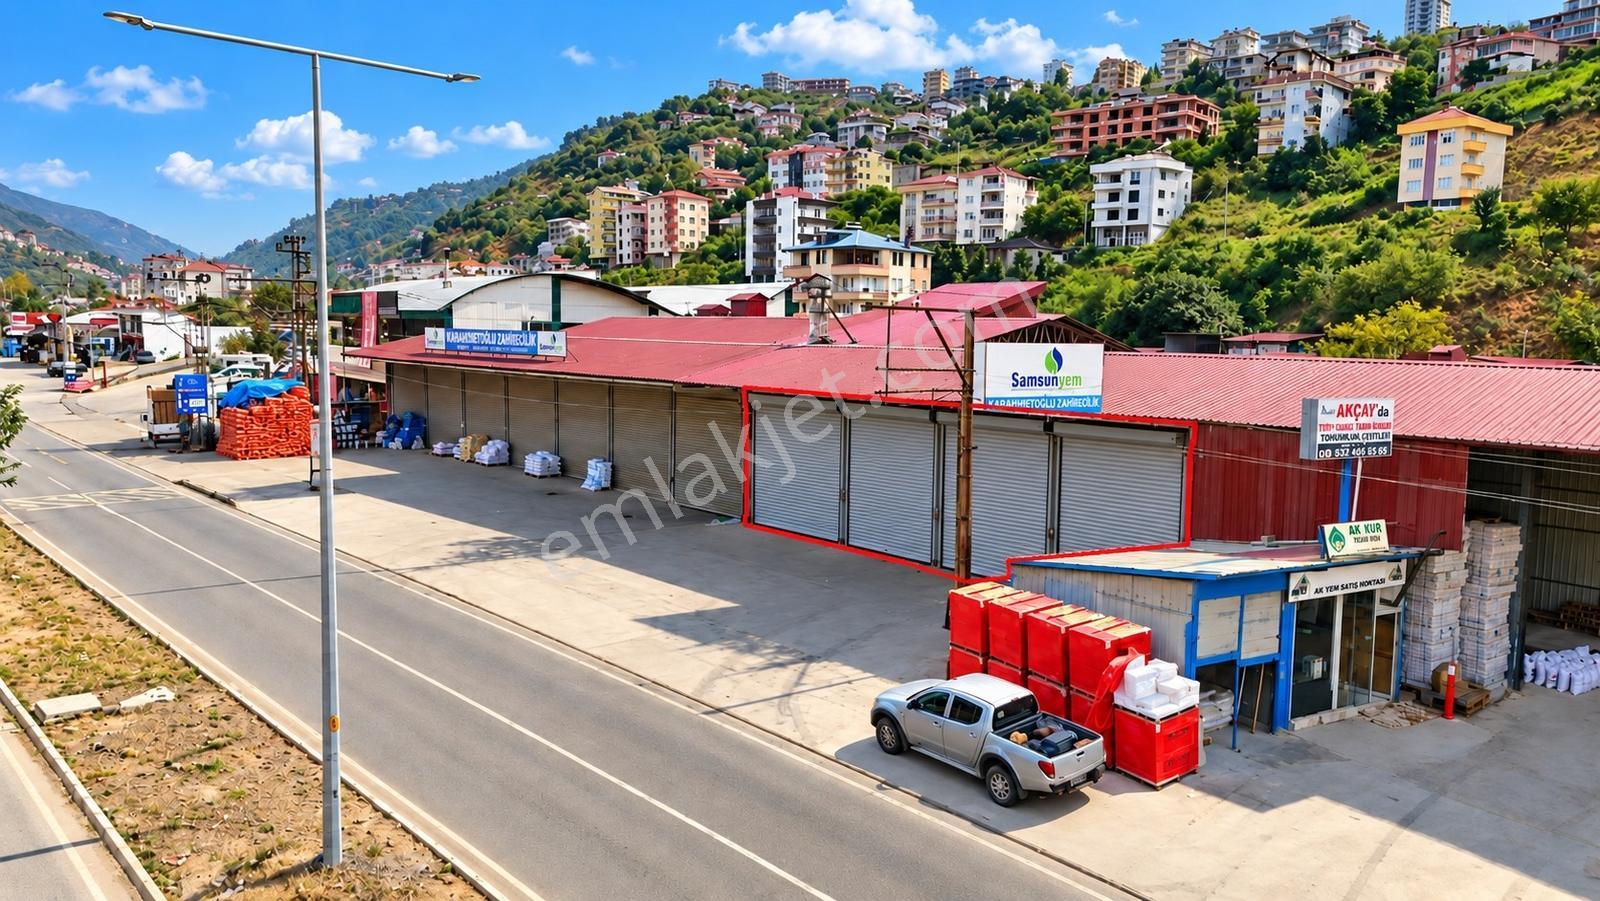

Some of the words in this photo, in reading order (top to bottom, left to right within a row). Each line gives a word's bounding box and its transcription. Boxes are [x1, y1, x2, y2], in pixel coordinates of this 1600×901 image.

[1011, 372, 1082, 390] Samsunyem
[1336, 403, 1389, 421] AKÇAY'da
[1349, 525, 1361, 535] AK
[1363, 522, 1382, 534] KUR
[1325, 584, 1340, 593] YEM
